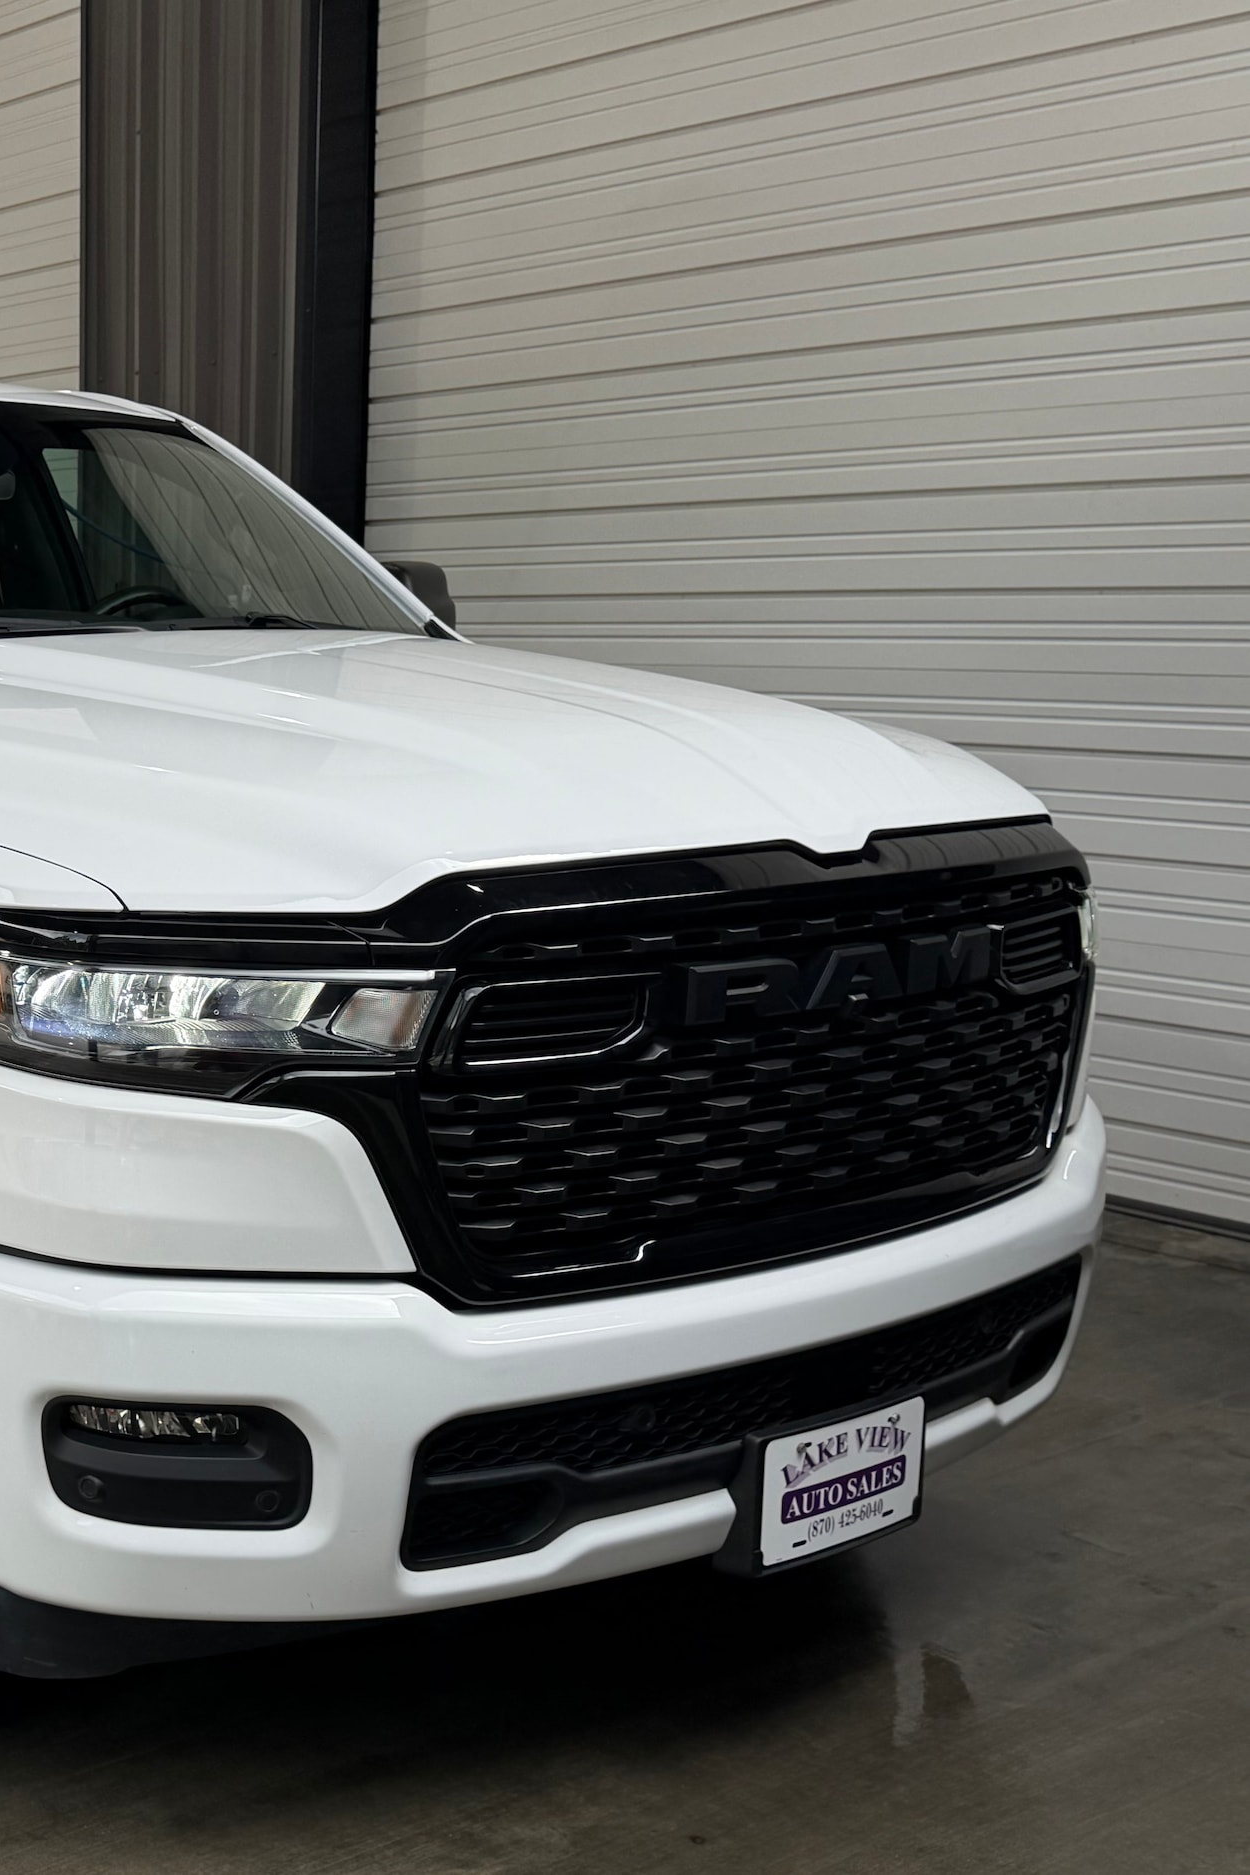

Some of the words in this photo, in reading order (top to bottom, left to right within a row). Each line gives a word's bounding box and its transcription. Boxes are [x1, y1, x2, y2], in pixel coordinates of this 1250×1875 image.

[675, 923, 993, 1028] RAM
[781, 1431, 849, 1488] LAKE
[855, 1424, 913, 1455] VIEW
[786, 1481, 844, 1520] AUTO
[846, 1461, 903, 1501] SALES
[807, 1515, 835, 1542] (870)
[838, 1498, 884, 1530] 425-6040
